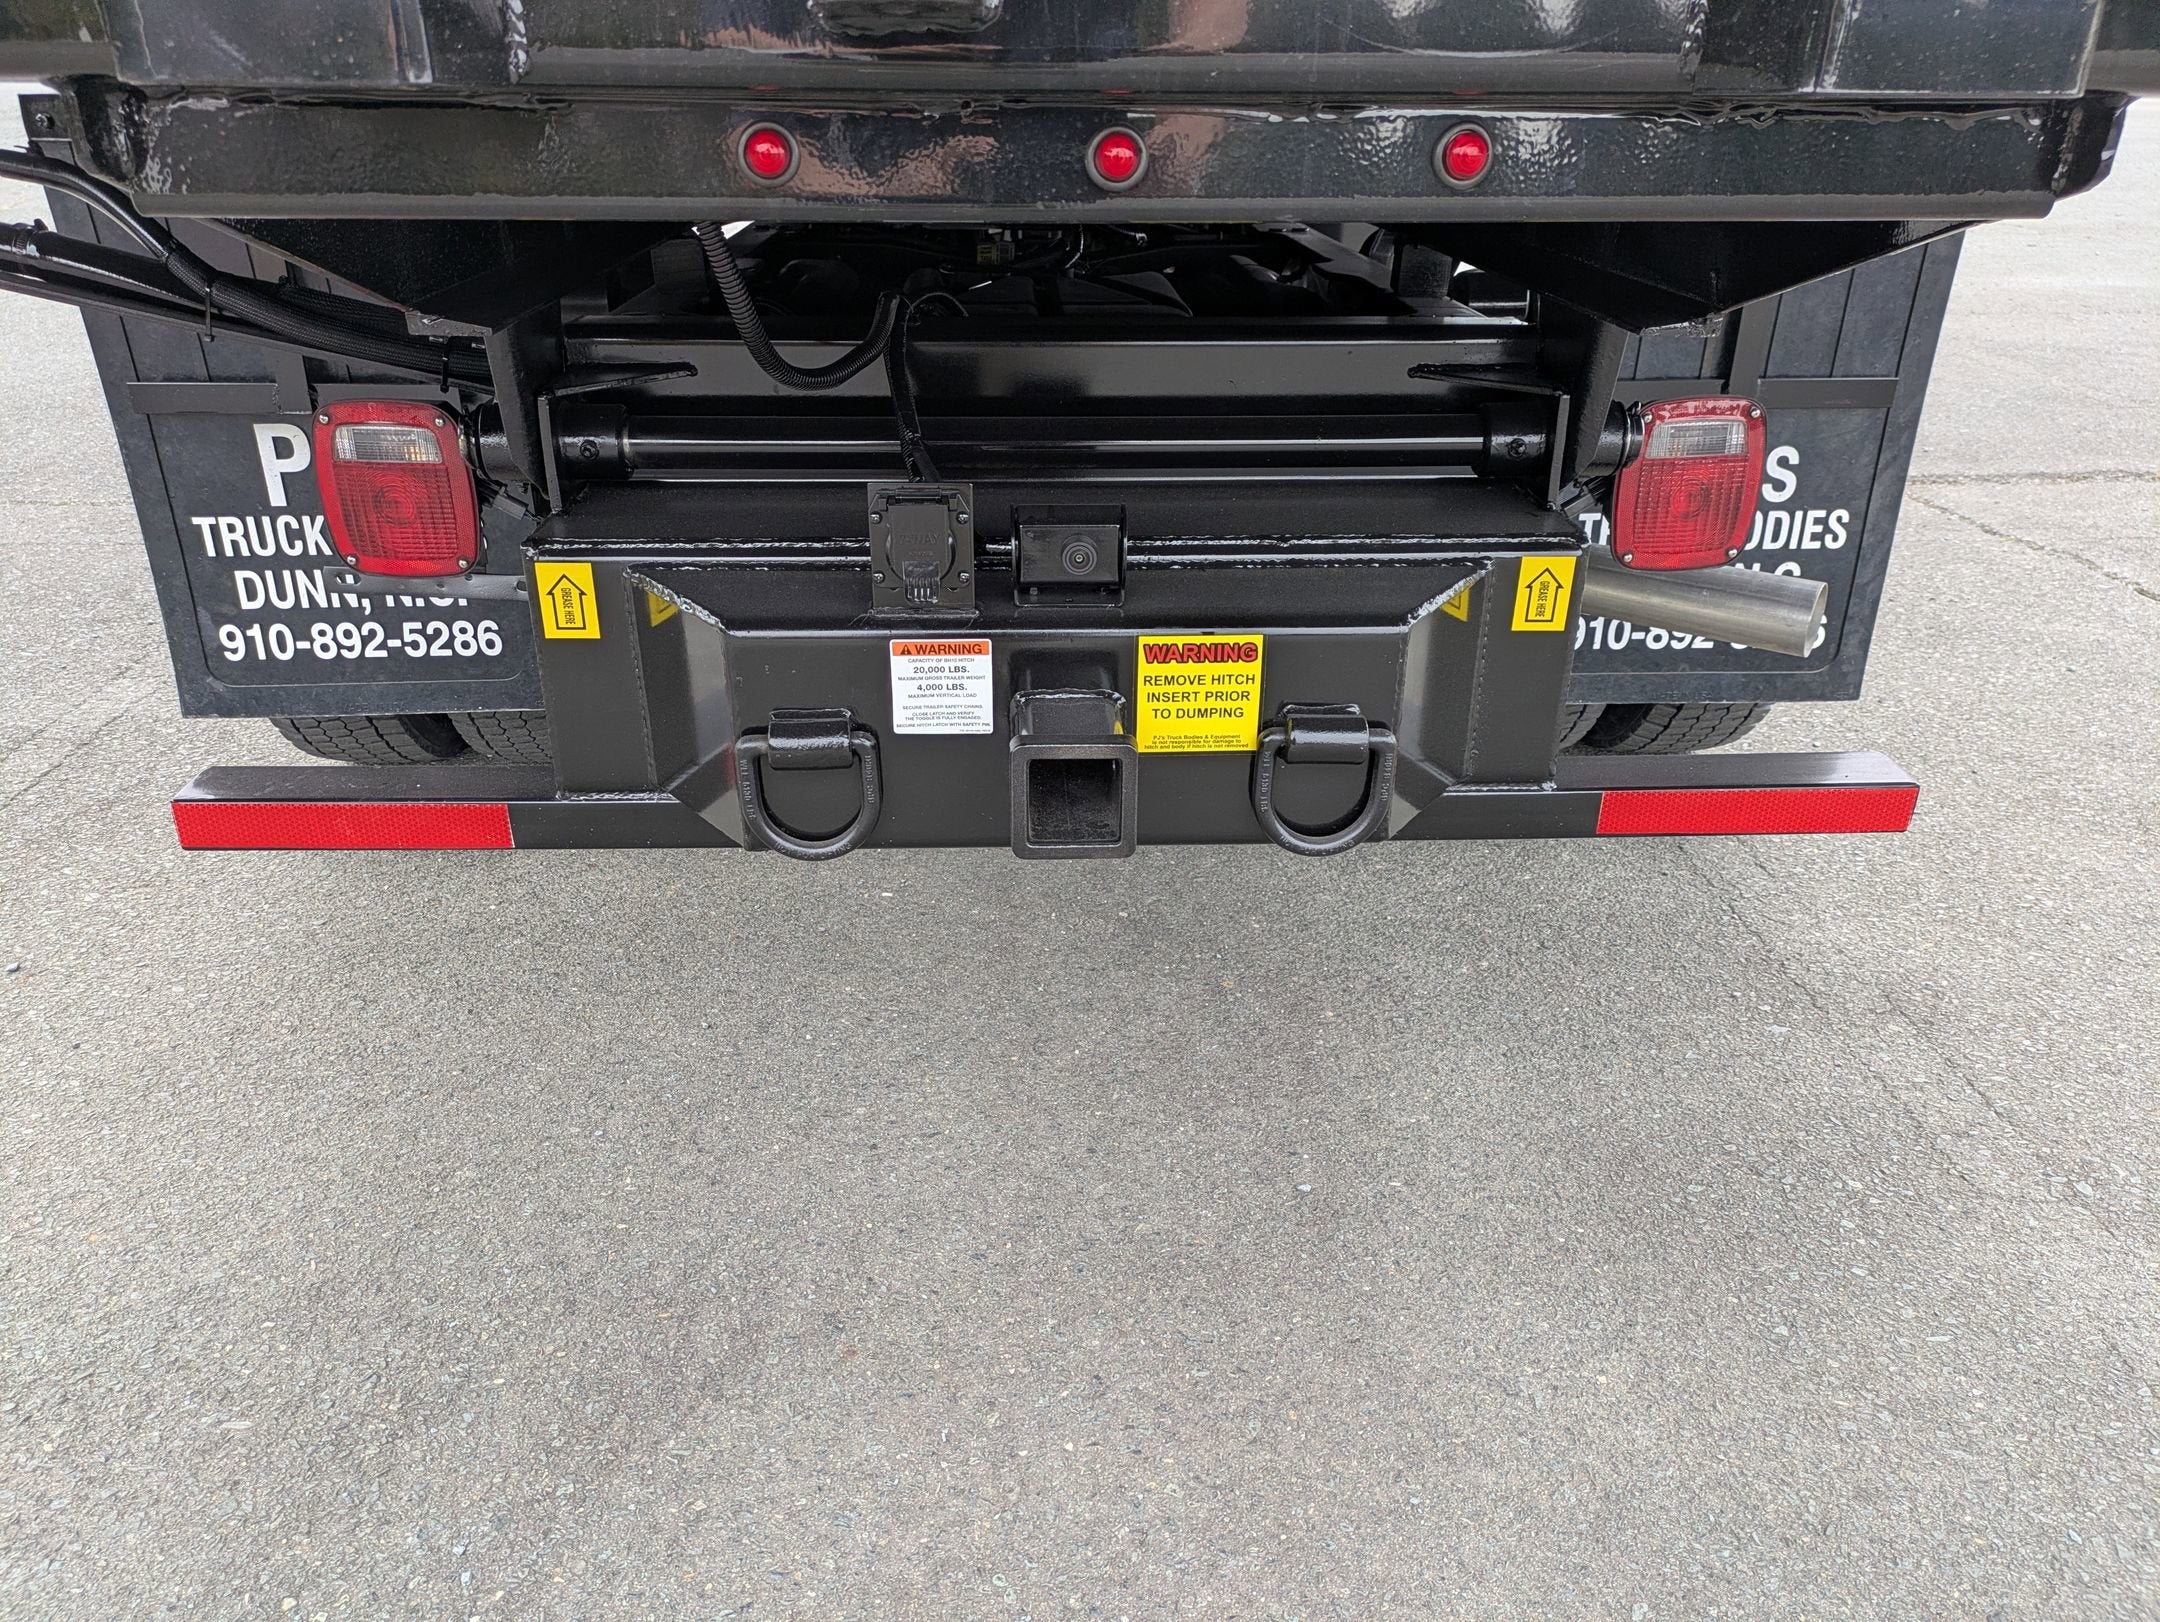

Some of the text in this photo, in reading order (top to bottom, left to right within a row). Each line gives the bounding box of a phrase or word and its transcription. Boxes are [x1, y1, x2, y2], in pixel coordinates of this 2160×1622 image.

[253, 423, 312, 507] P
[1762, 446, 1800, 503] S
[192, 515, 334, 557] TRUCK
[561, 587, 576, 625] GREASE HERE
[1535, 580, 1550, 618] GREASE HERE
[218, 620, 503, 661] 910-892-5286
[914, 643, 982, 655] WARNING
[1143, 642, 1258, 664] WARNING
[913, 665, 970, 674] 20,000 LBS.
[1143, 674, 1255, 686] REMOVE HITCH
[916, 683, 968, 692] 4,000 LBS.
[1147, 690, 1250, 703] INSERT PRIOR
[1152, 707, 1244, 719] TO DUMPING
